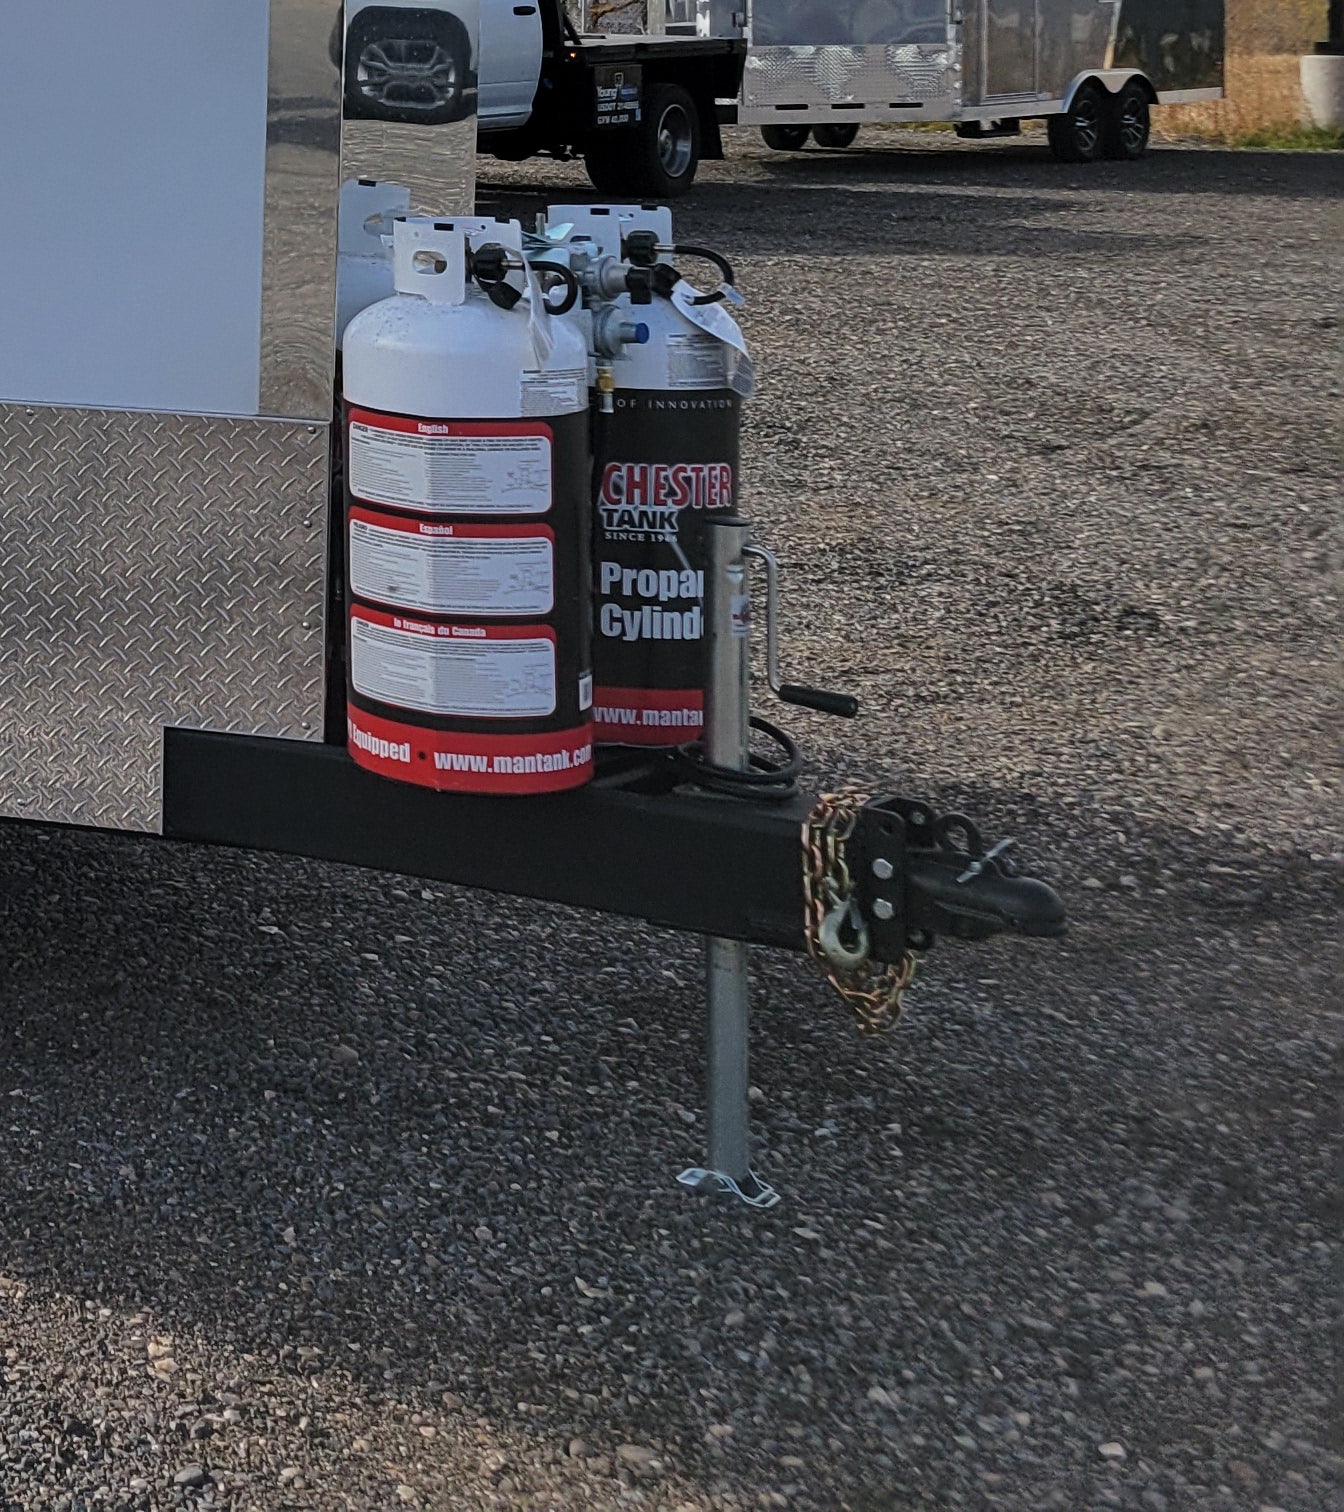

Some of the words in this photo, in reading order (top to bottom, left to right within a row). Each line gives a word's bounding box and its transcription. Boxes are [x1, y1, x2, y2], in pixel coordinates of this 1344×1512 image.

[616, 398, 637, 408] OF
[648, 399, 733, 409] INNOVATION
[418, 423, 448, 434] English
[601, 462, 732, 509] CHESTER
[600, 507, 679, 531] TANK
[419, 524, 453, 535] Español
[605, 532, 645, 541] SINCE
[600, 603, 704, 641] Cylind
[353, 723, 410, 763] Equipped
